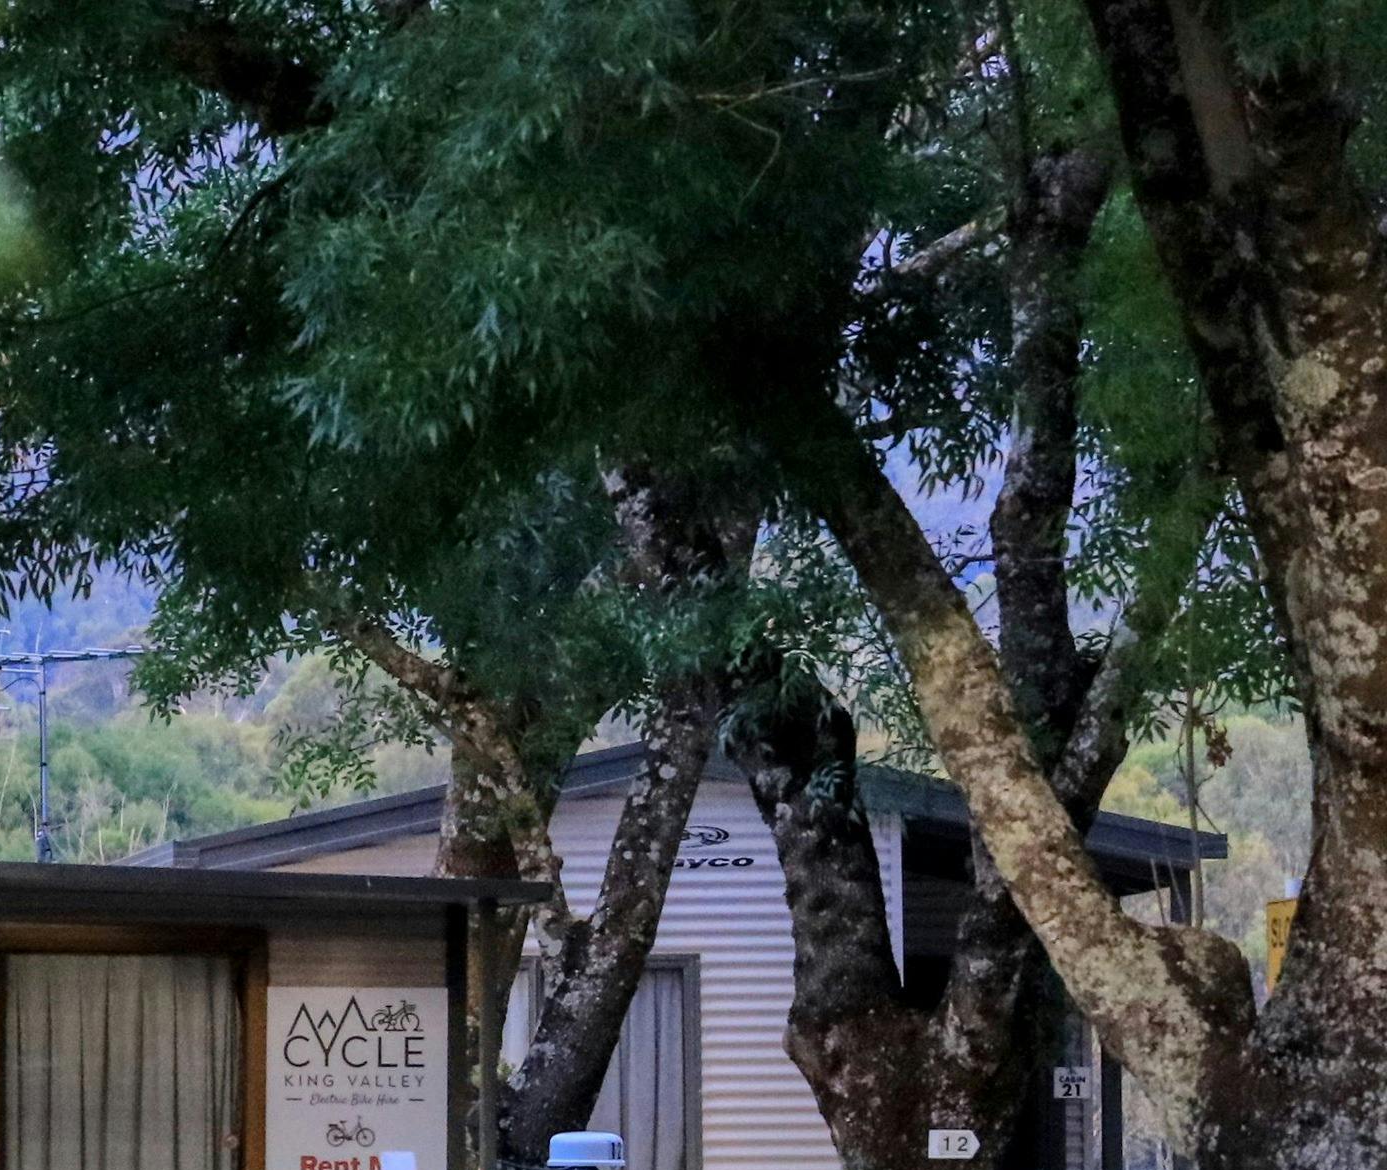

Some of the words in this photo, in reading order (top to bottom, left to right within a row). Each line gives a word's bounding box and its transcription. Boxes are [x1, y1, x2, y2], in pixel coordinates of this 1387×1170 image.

[283, 1024, 426, 1068] CYCLE
[284, 1075, 335, 1088] KING
[347, 1075, 426, 1088] VALLEY
[1062, 1083, 1081, 1097] 21
[309, 1093, 347, 1106] Electric
[350, 1093, 373, 1106] Bike
[942, 1136, 969, 1152] 12
